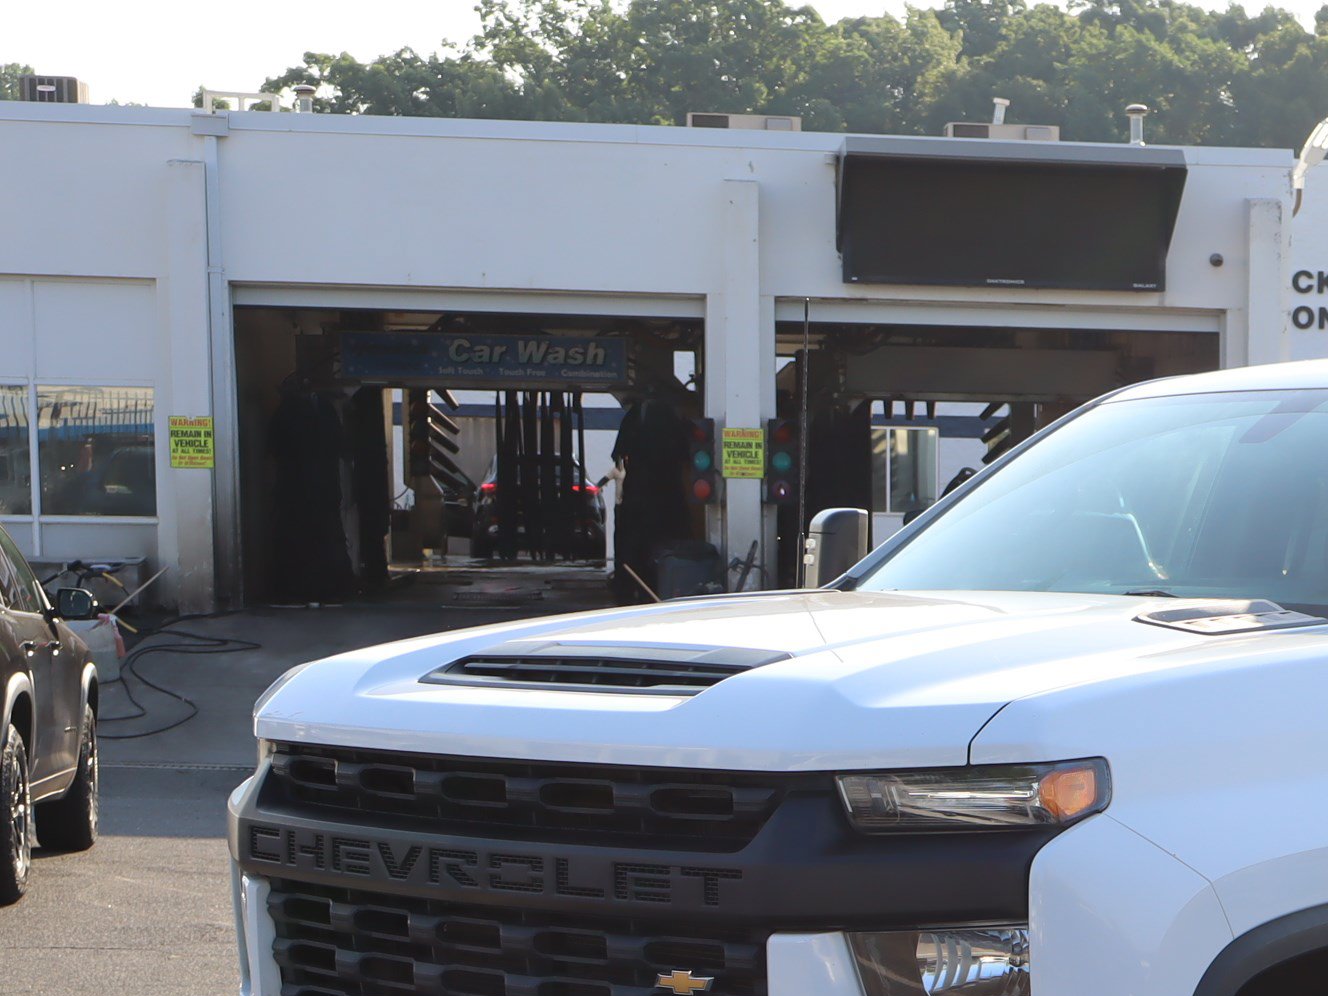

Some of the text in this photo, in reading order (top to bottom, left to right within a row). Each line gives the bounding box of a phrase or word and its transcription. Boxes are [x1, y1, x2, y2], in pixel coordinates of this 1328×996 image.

[449, 338, 507, 364] Car
[518, 340, 606, 366] Wash
[457, 367, 484, 375] Touch
[499, 368, 526, 376] Touch
[527, 368, 546, 377] Free
[560, 368, 618, 378] Combination
[170, 429, 212, 438] REMAIN IN
[174, 439, 209, 448] VEHICLE
[723, 441, 752, 449] REMAIN
[726, 450, 759, 458] VEHICLE
[250, 825, 743, 906] CHEVROLET
